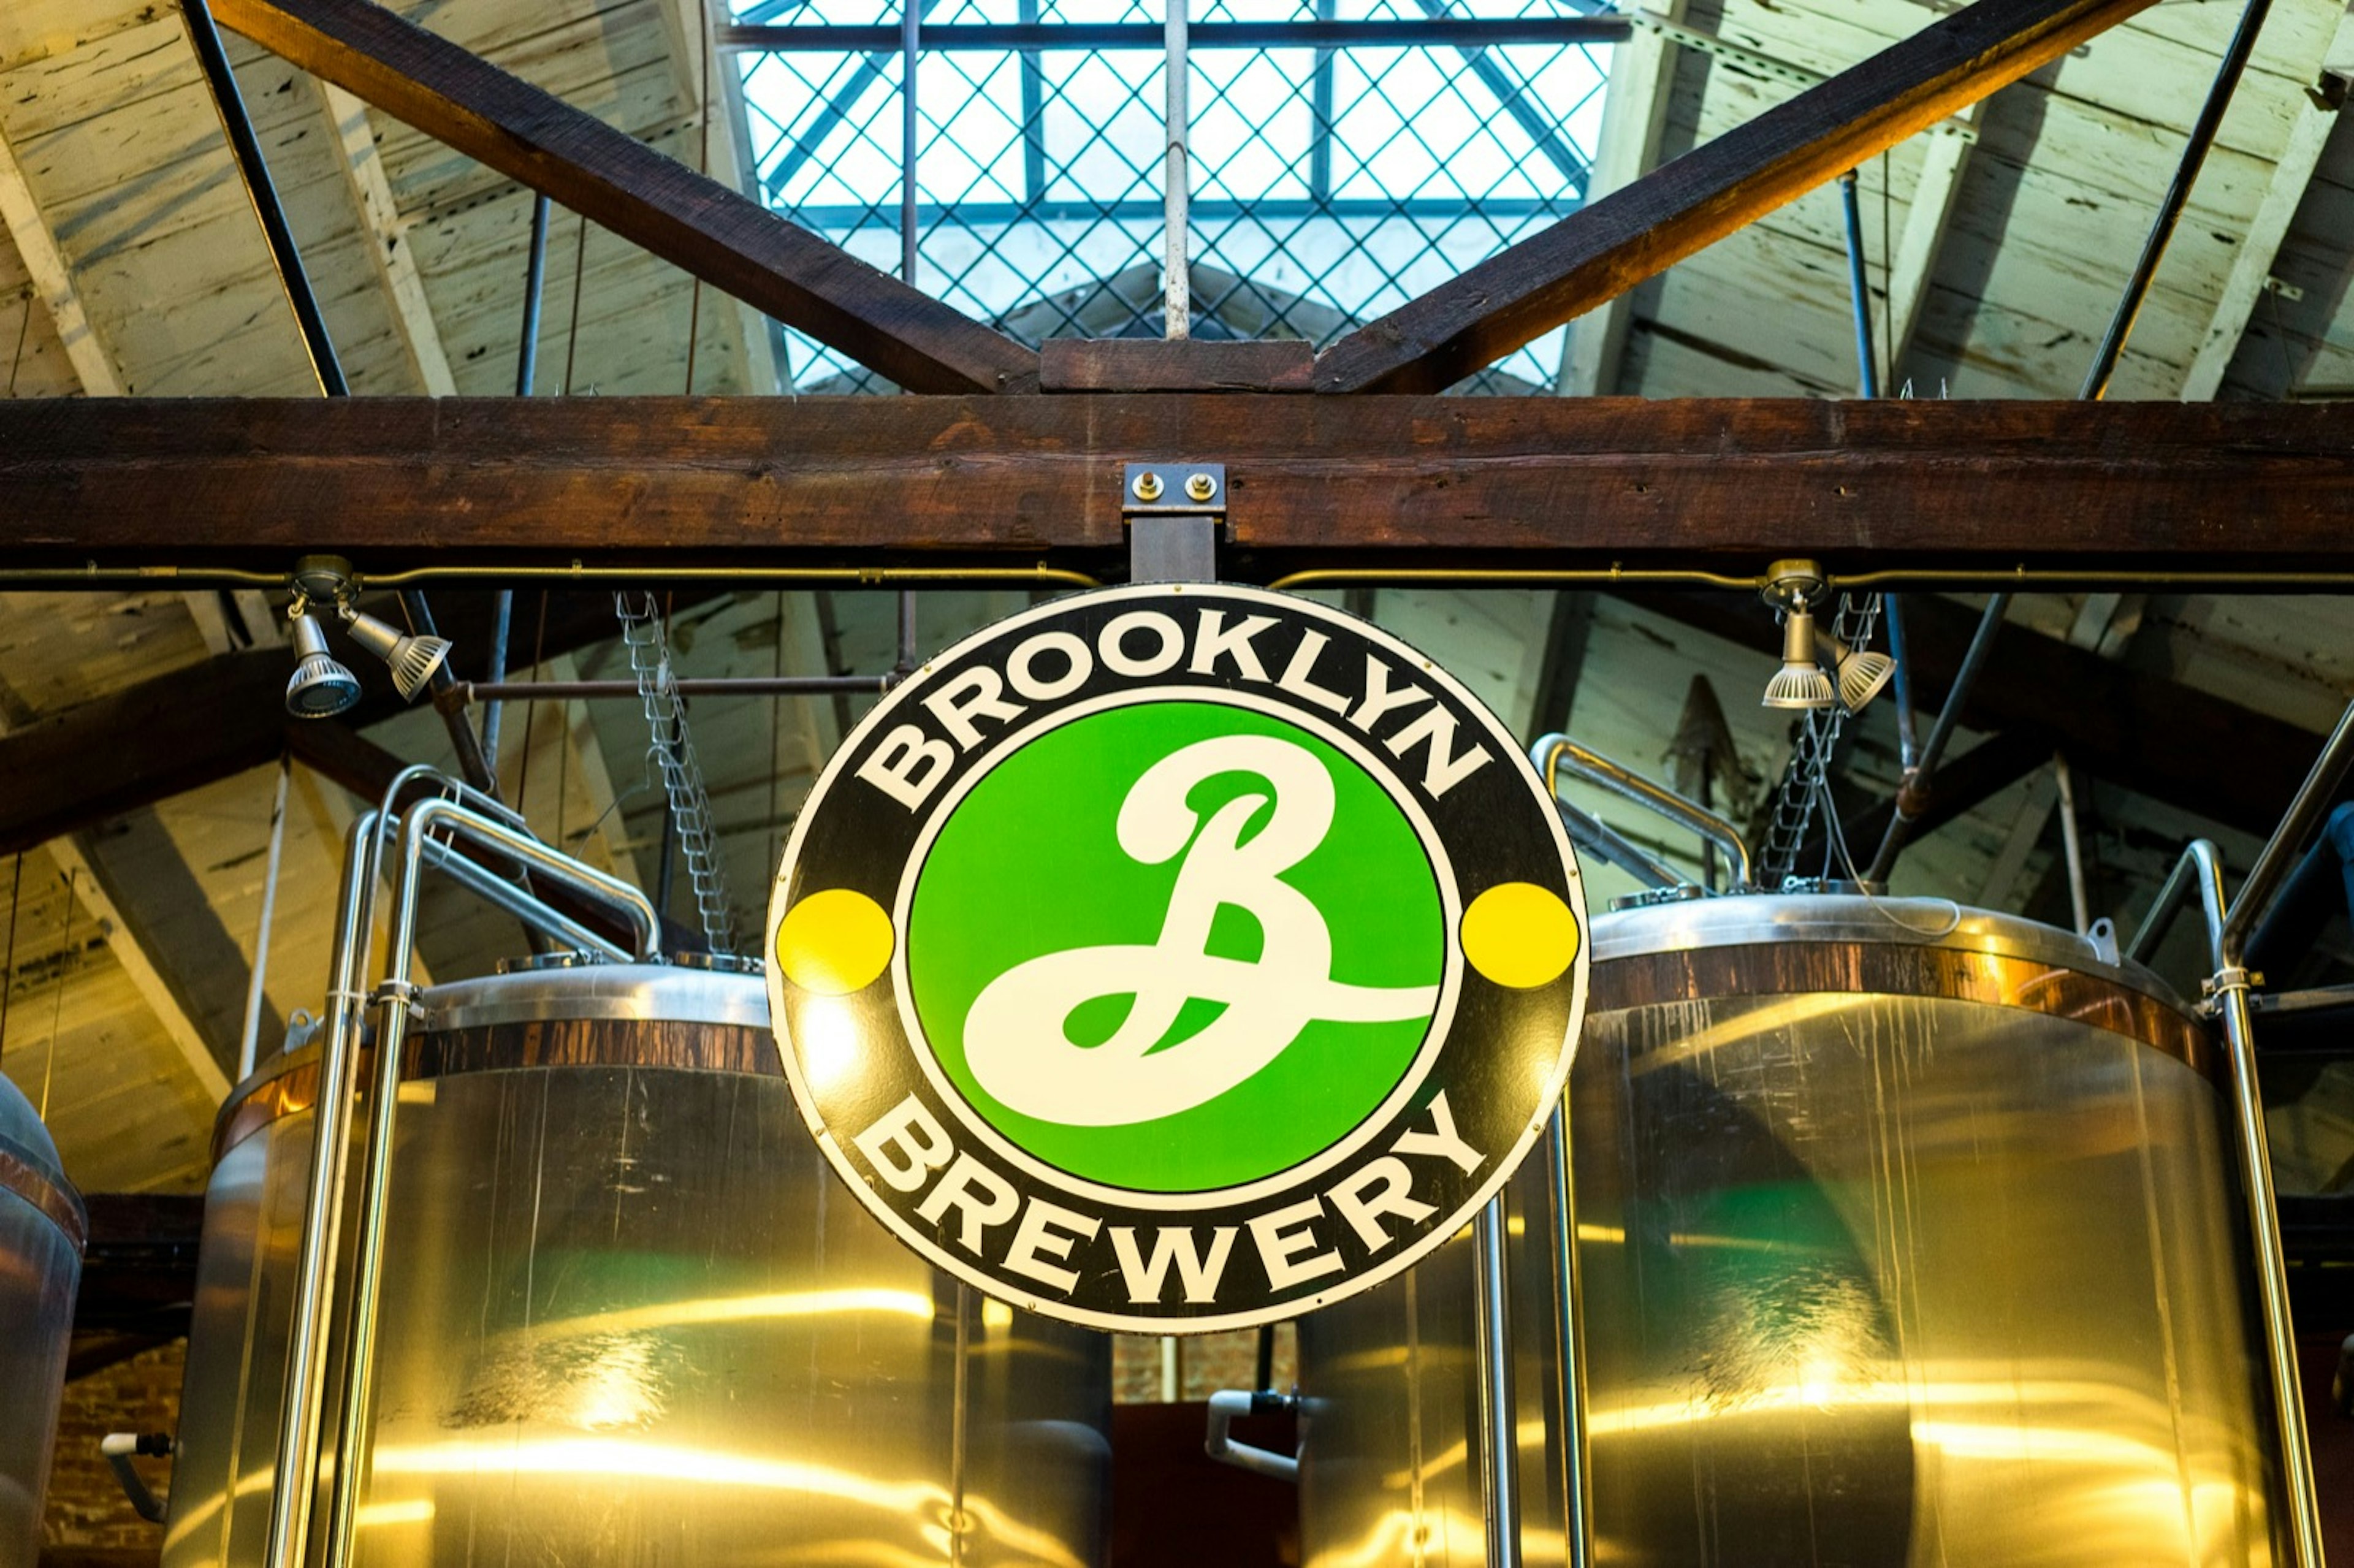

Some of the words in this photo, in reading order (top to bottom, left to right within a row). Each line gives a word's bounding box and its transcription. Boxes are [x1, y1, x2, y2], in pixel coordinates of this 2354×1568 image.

[854, 608, 1494, 814] BROOKLYN
[963, 735, 1440, 1126] B
[851, 1089, 1487, 1303] BREWERY
